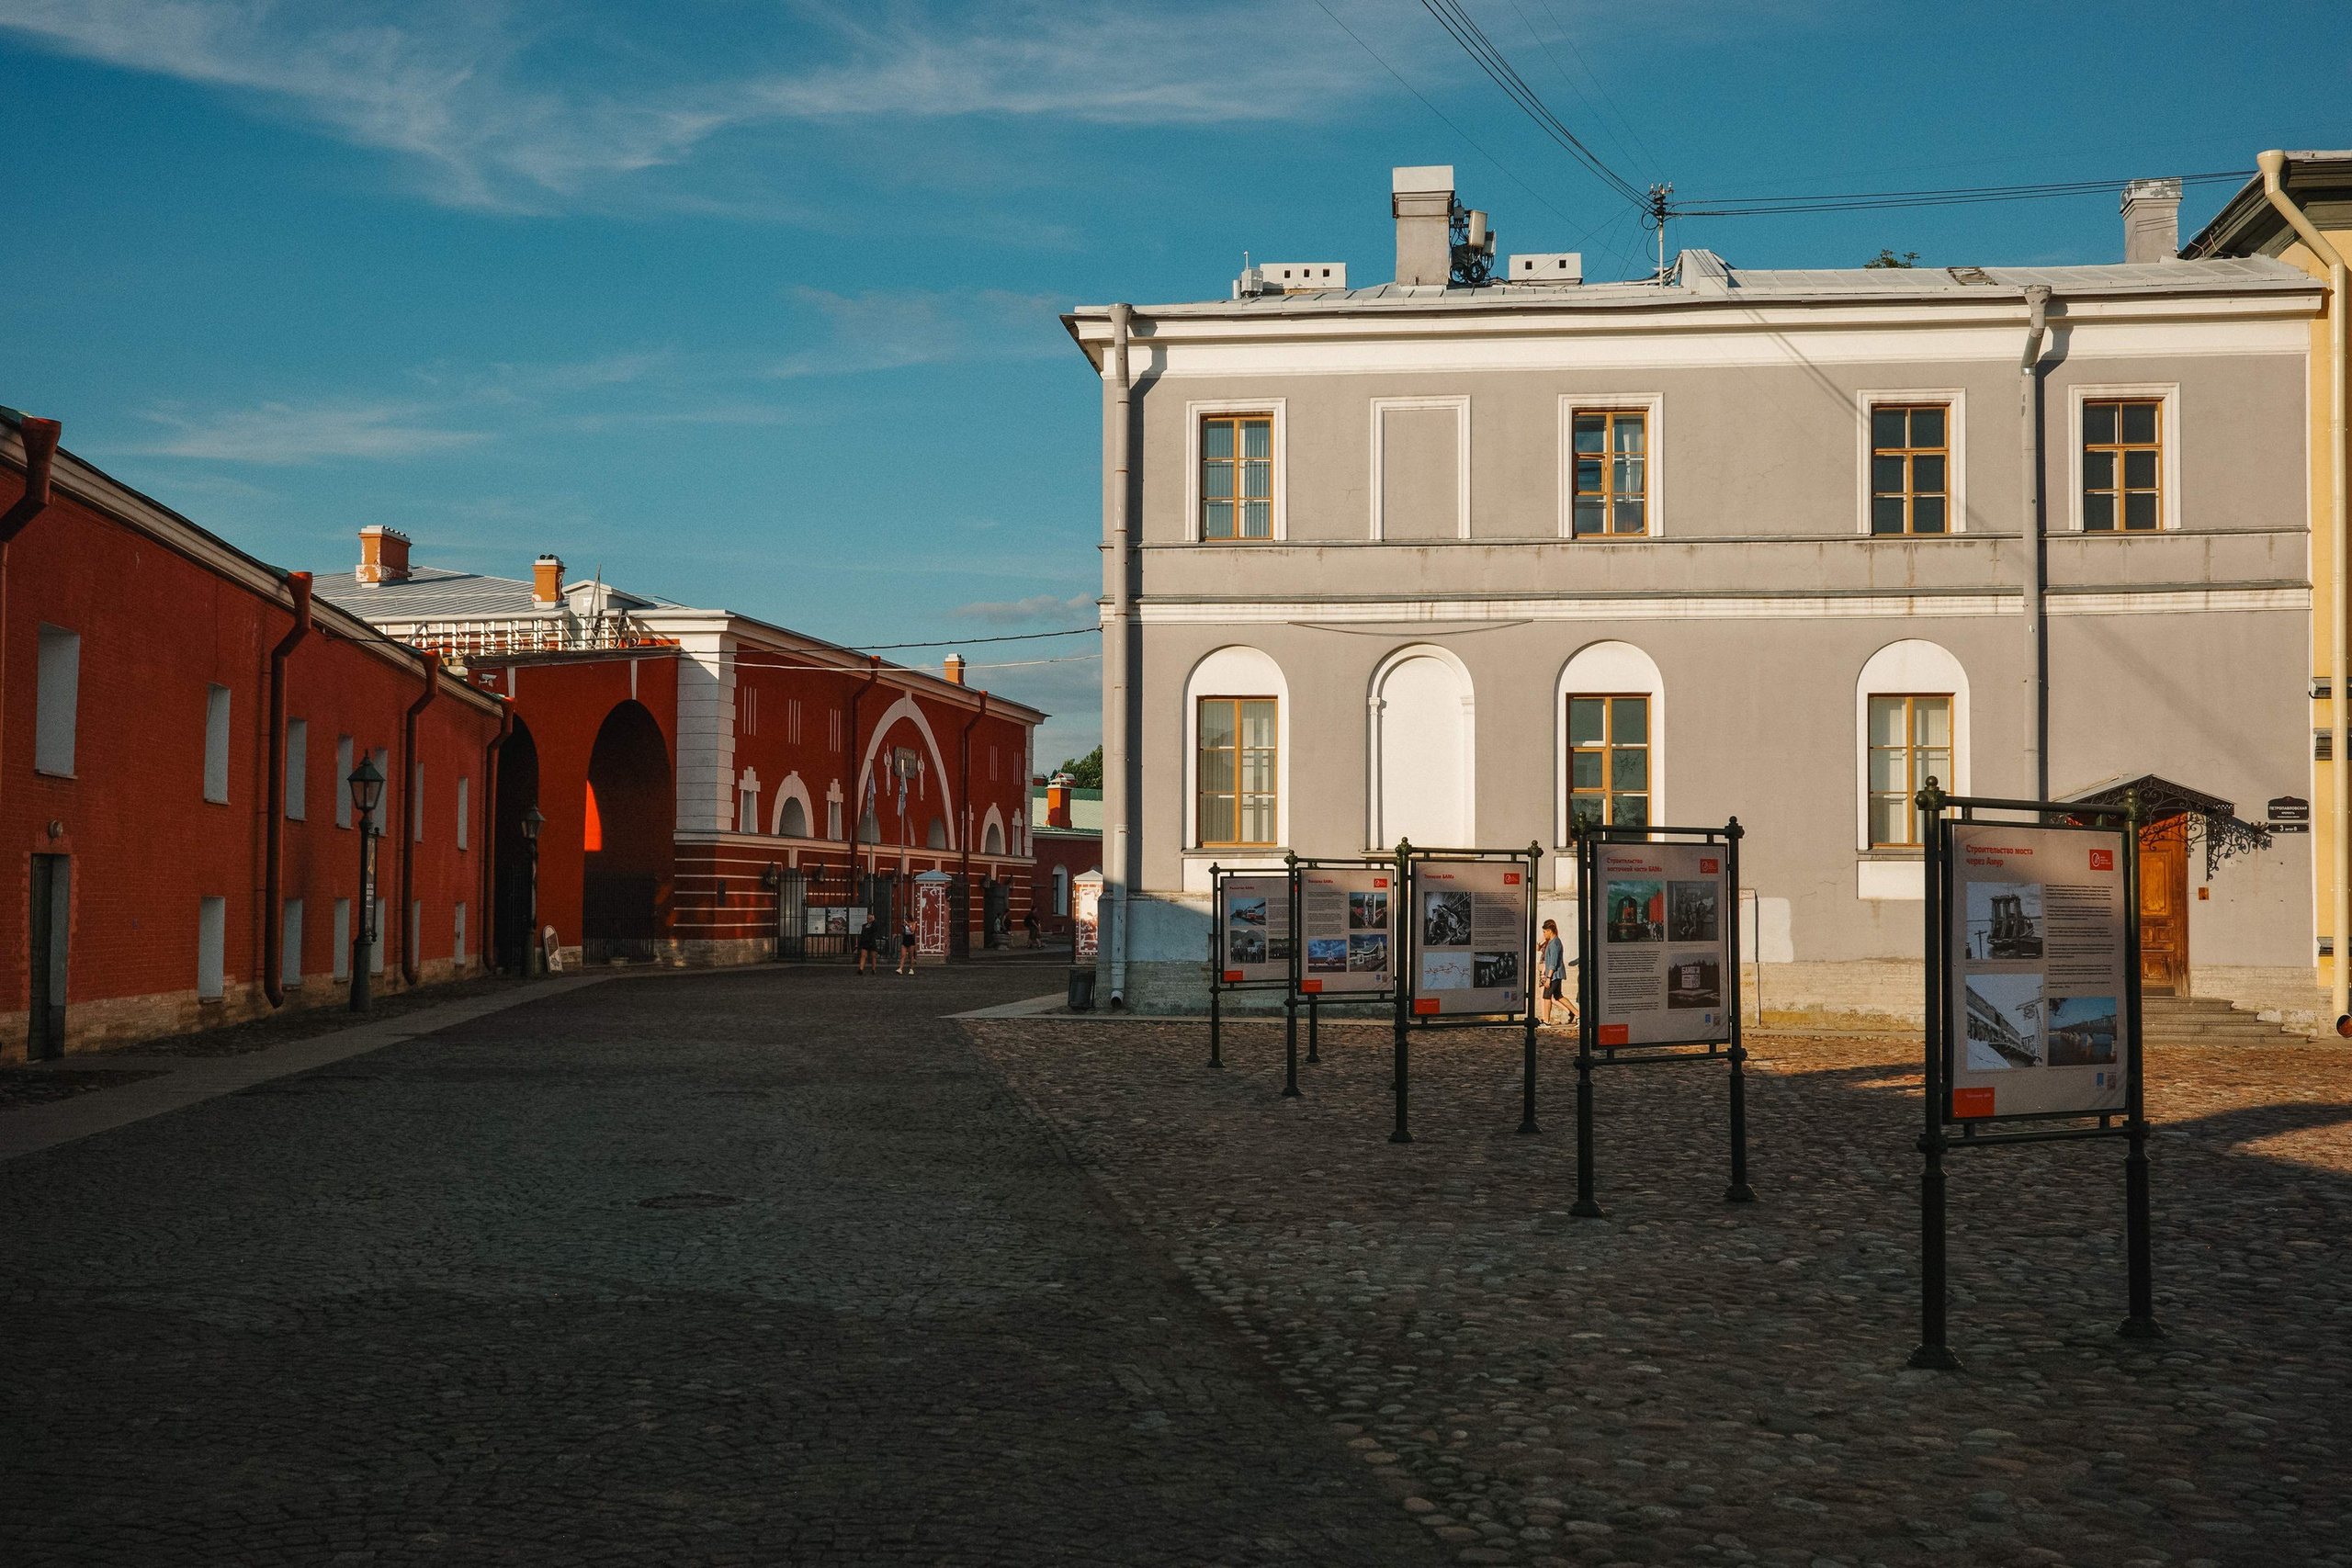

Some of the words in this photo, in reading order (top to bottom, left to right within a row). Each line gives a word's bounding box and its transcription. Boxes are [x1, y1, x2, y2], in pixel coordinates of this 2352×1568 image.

[1966, 844, 2014, 855] Строительство
[1966, 858, 1985, 866] через
[1986, 857, 2004, 867] Амур
